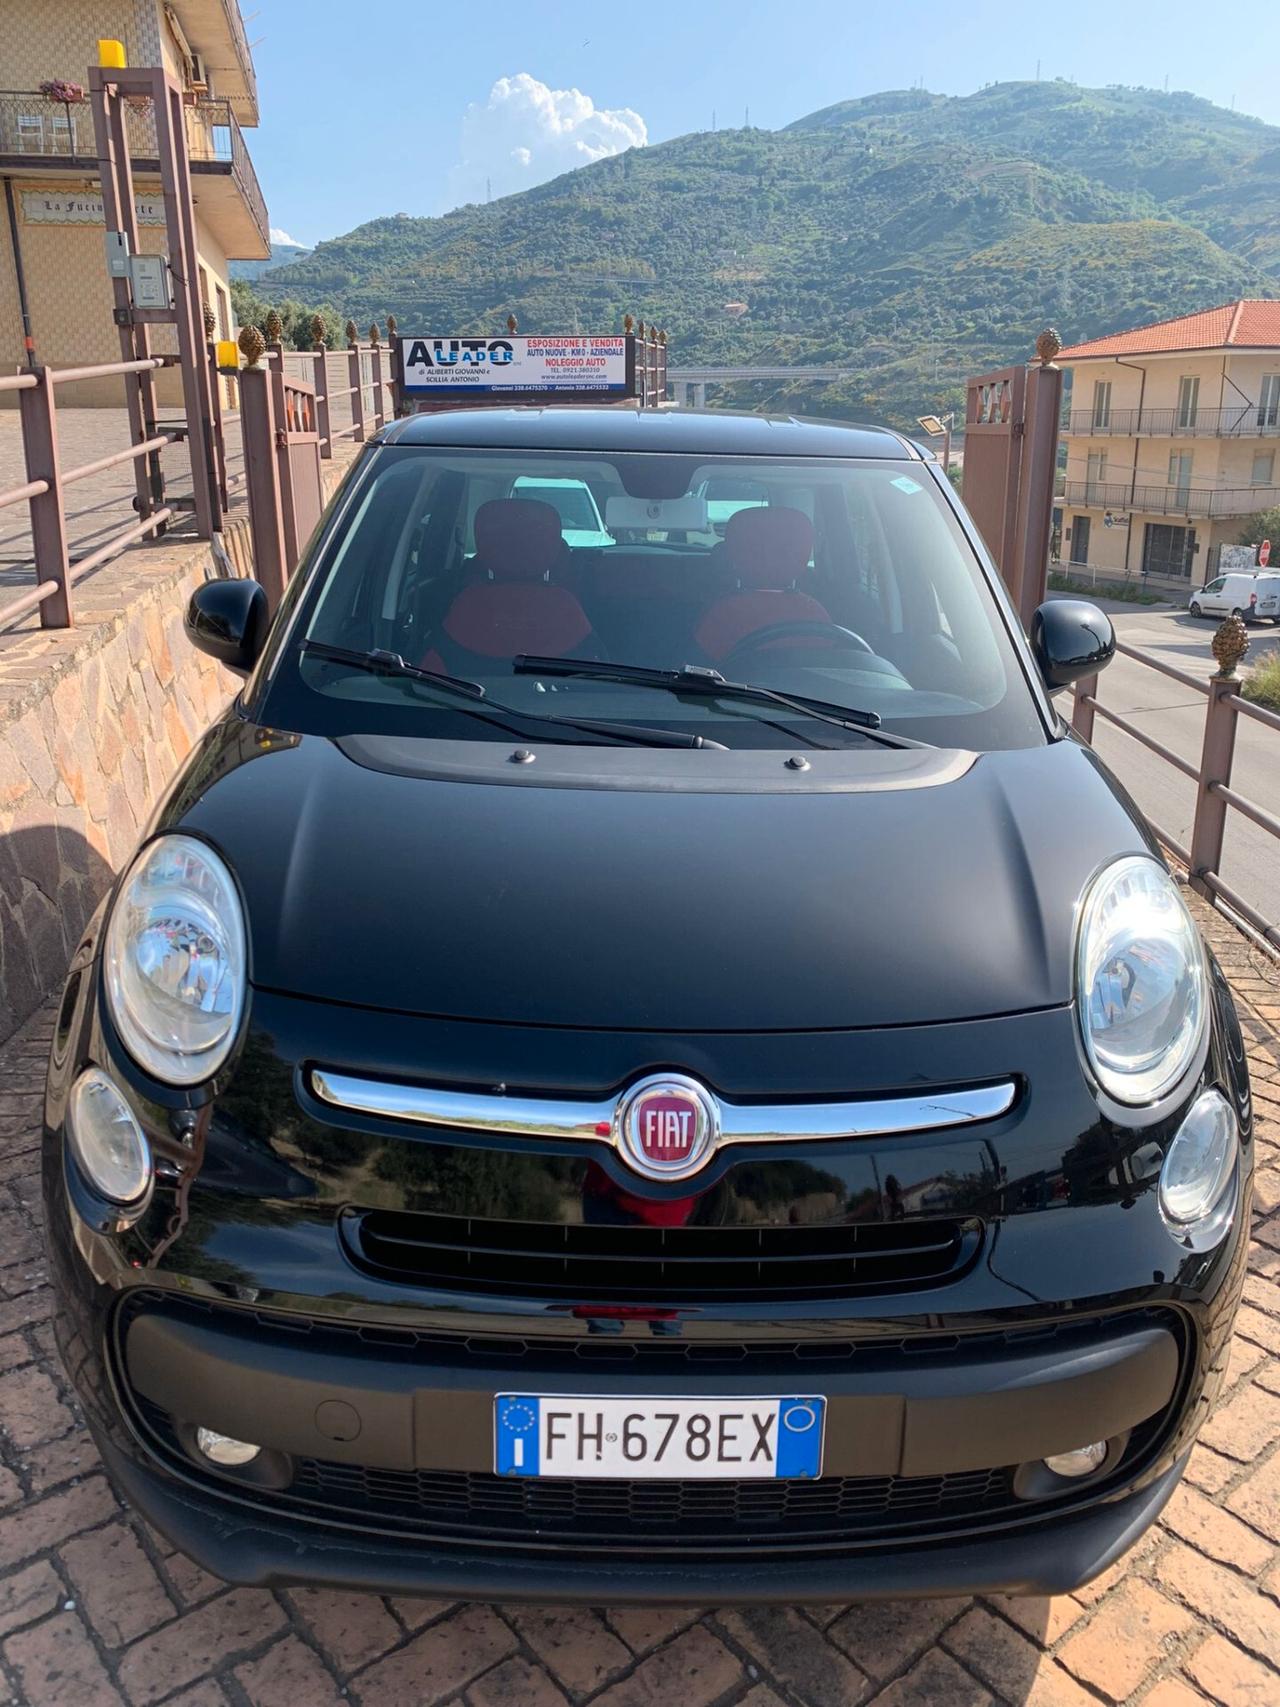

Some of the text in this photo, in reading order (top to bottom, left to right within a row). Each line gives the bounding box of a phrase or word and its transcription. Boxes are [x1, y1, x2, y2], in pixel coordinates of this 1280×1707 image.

[44, 201, 60, 211] La
[65, 201, 103, 213] Fucin
[527, 340, 580, 348] ESPOSIZIONE
[590, 339, 624, 347] VENDITA
[435, 350, 514, 361] LEADER
[527, 349, 544, 357] AUTO
[590, 348, 623, 356] AZIENDALE
[545, 358, 606, 367] NOLEGGIO AUTO
[646, 1110, 692, 1148] FIAT
